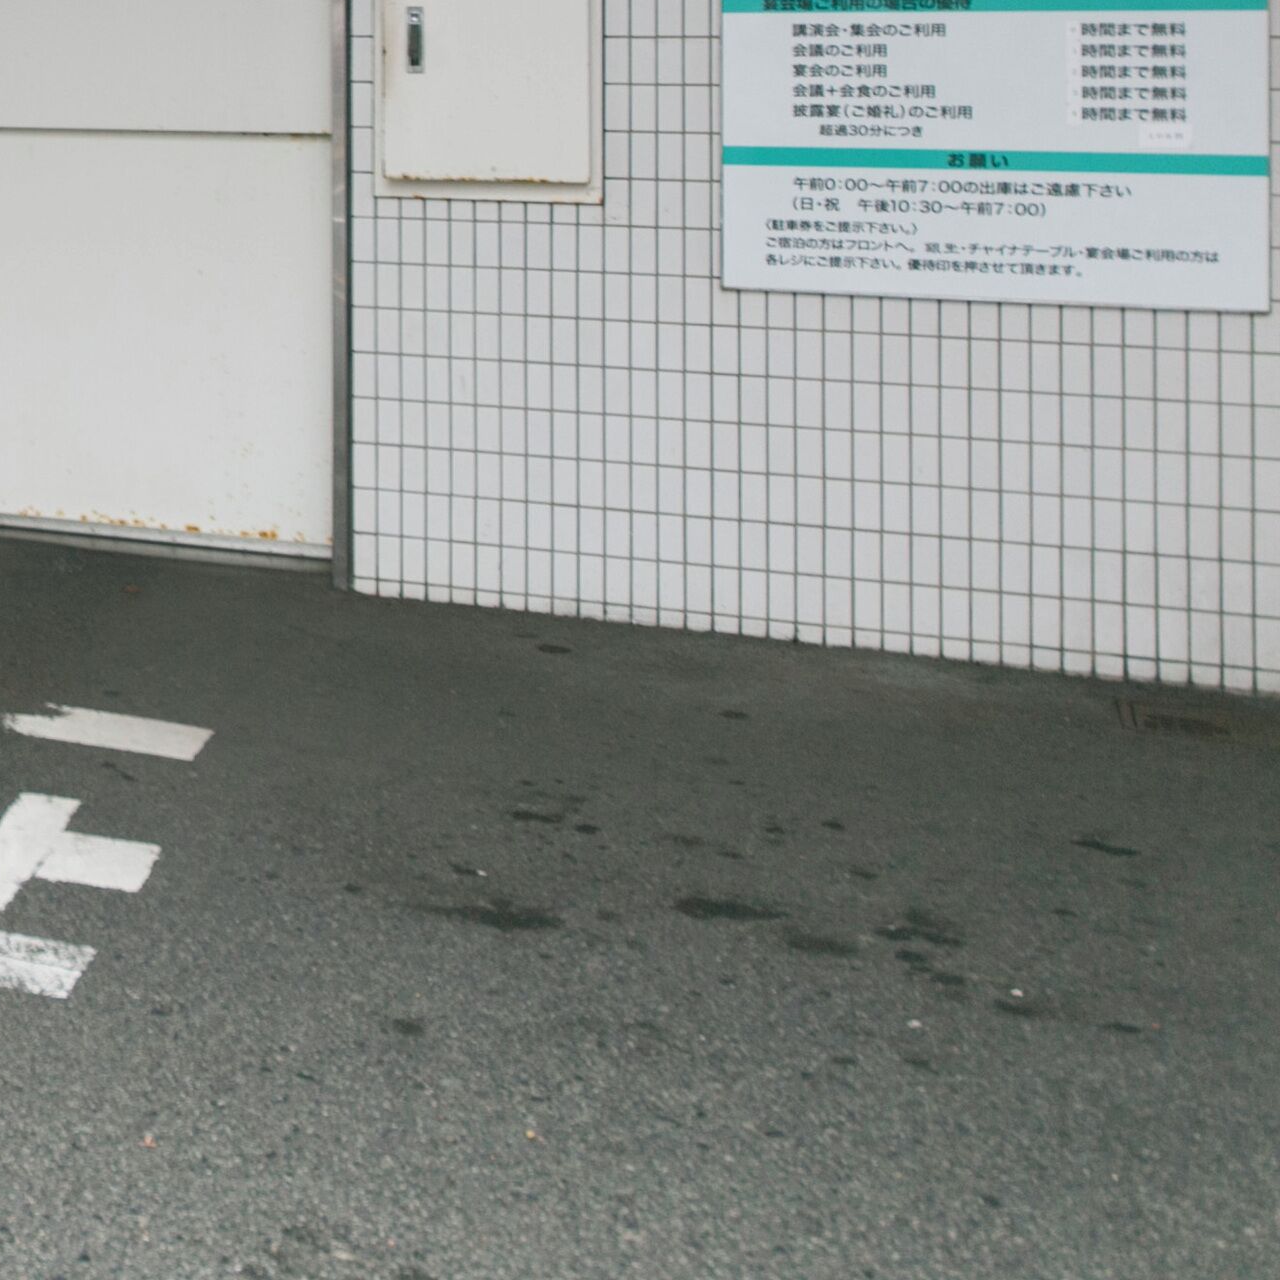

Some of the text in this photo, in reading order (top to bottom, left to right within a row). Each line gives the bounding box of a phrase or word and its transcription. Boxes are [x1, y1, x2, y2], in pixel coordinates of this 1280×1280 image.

[792, 22, 947, 38] 講演会・集会のご利用
[792, 43, 888, 58] 会議のご利用
[792, 63, 888, 79] 宴会のご利用
[792, 84, 936, 99] 会議+会食のご利用
[819, 124, 923, 138] 超過30分につき
[946, 153, 1009, 169] お願い
